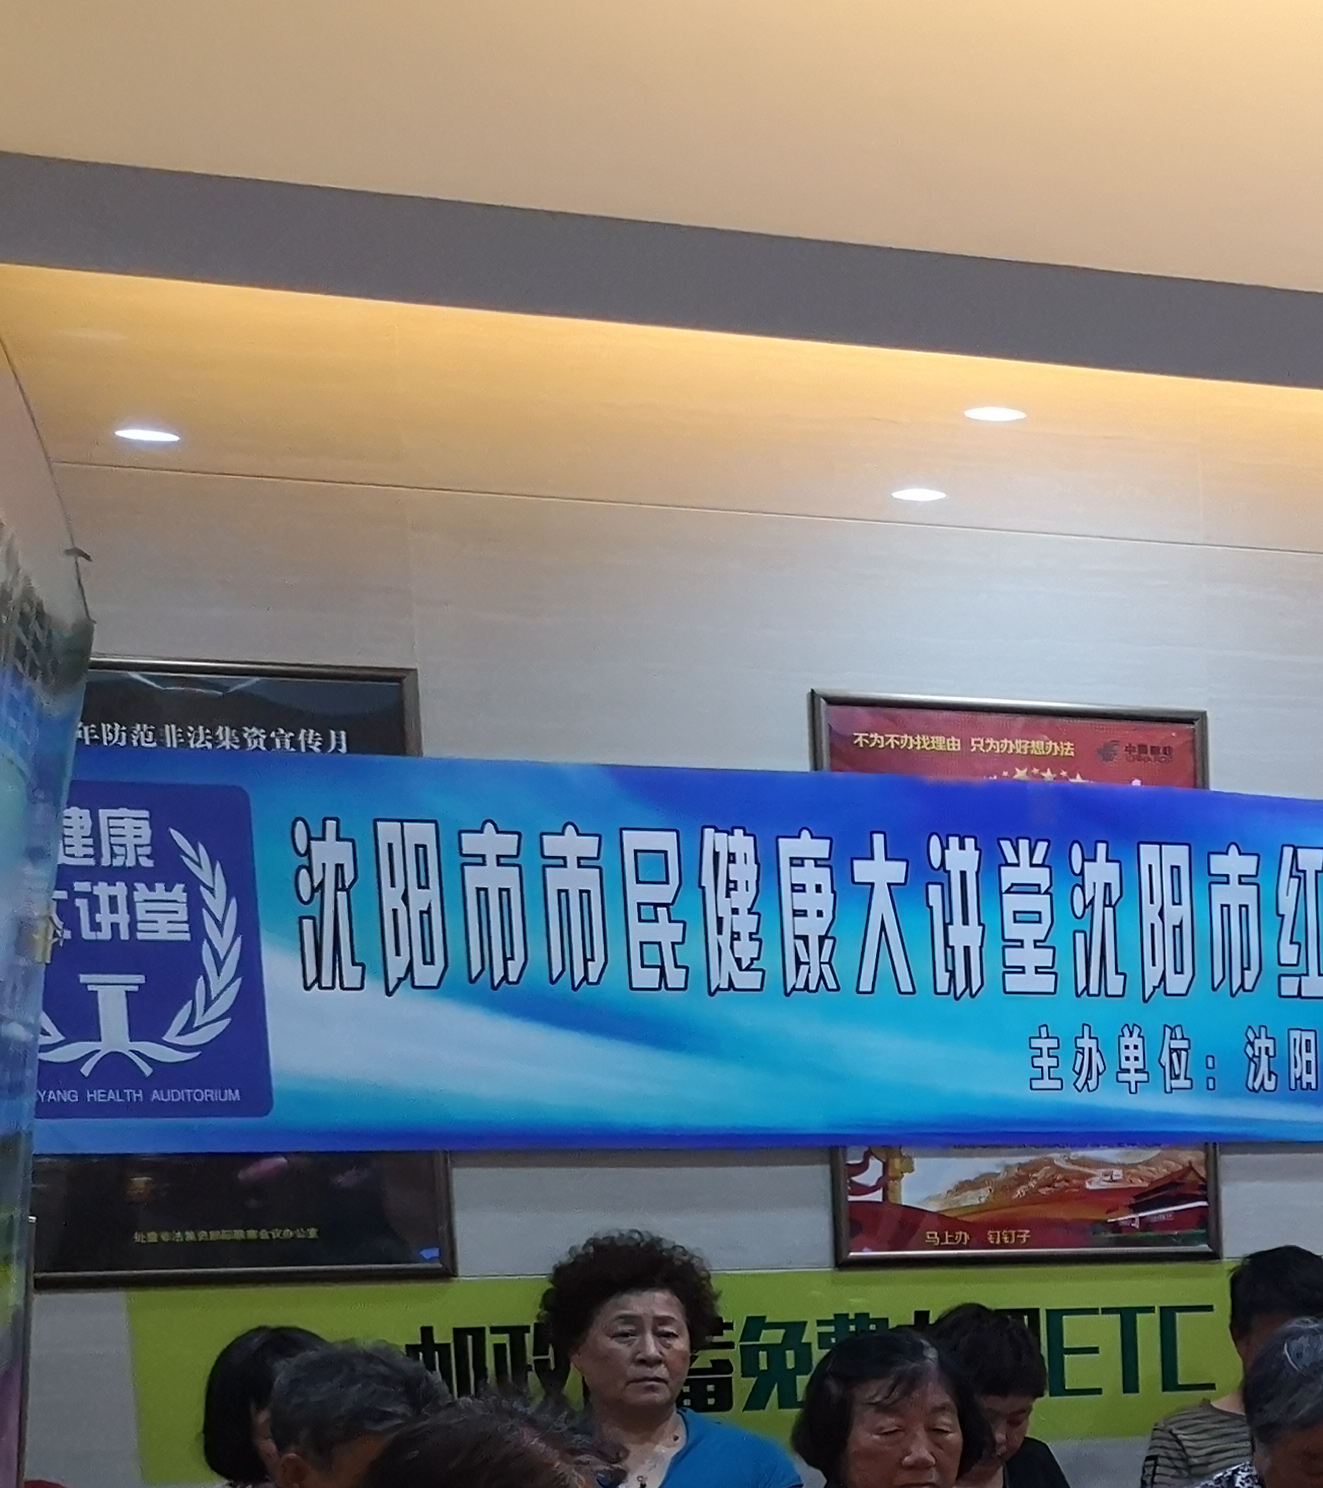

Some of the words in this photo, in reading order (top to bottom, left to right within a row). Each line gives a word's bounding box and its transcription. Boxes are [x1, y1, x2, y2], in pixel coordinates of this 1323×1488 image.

[75, 721, 348, 754] 年防范非法集资宣传月
[853, 732, 961, 753] 不为不办找理由
[970, 736, 1076, 758] 只为办好想办法
[58, 806, 154, 867] 健康
[53, 881, 191, 941] 讲堂
[86, 1089, 143, 1102] HEALTH
[151, 1088, 241, 1102] AUDITORIUM
[925, 1230, 971, 1246] 马上办
[986, 1229, 1032, 1245] 钉钉子
